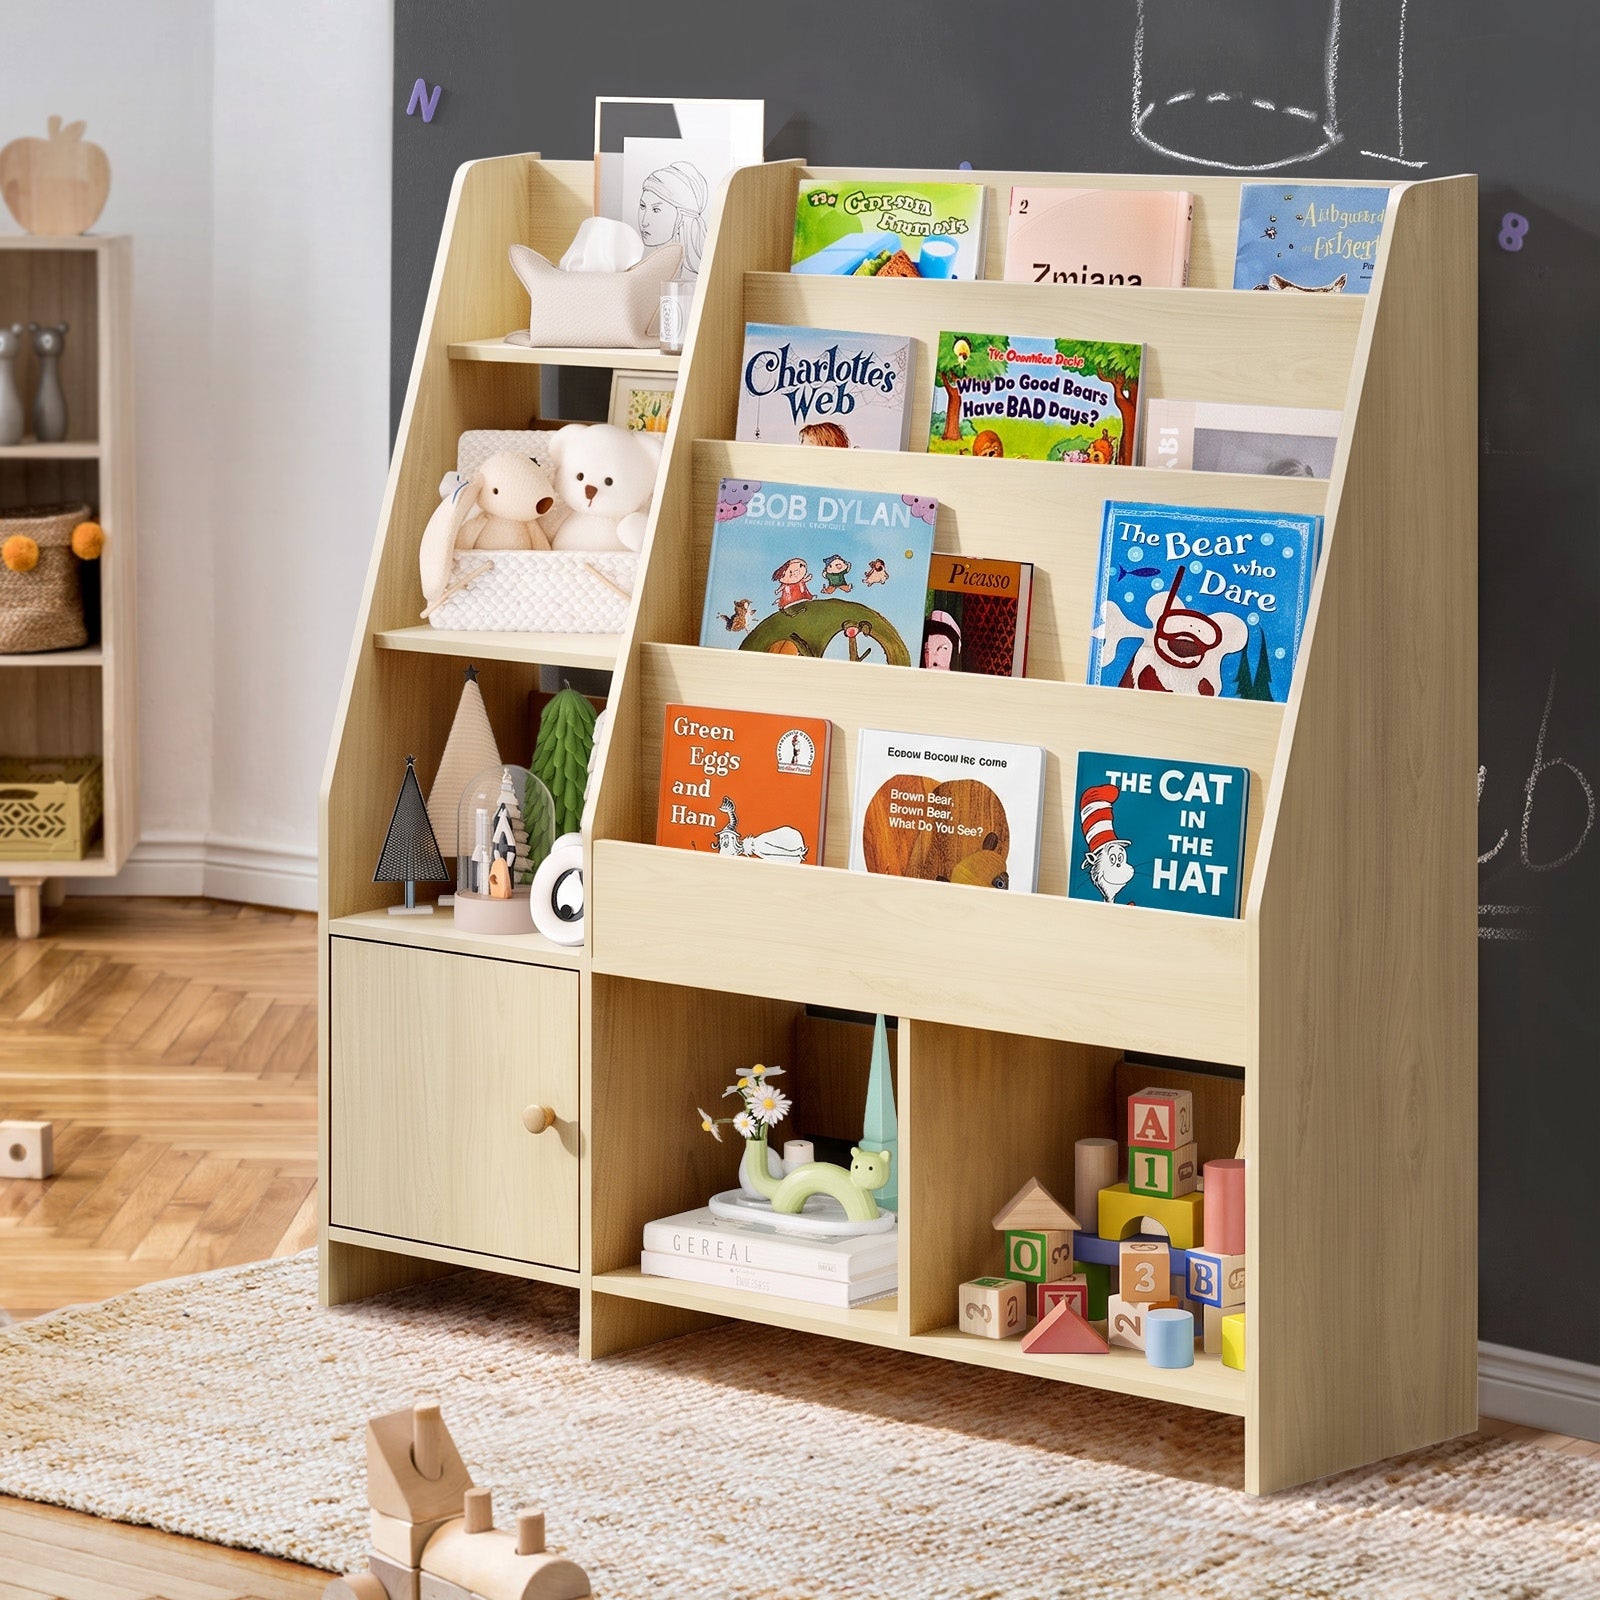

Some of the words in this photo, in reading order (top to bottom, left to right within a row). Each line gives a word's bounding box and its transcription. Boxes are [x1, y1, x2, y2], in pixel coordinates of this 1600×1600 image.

[407, 78, 441, 123] N
[1019, 199, 1029, 214] 2
[1499, 212, 1529, 251] 8
[781, 382, 854, 425] Web
[957, 377, 991, 395] Why
[995, 376, 1015, 392] Do
[1019, 374, 1059, 393] Good
[1063, 379, 1108, 406] Bears
[963, 401, 1004, 418] Have
[1006, 396, 1046, 419] BAD
[1049, 402, 1099, 427] Days?
[746, 492, 807, 520] BOB
[818, 497, 910, 528] DYLAN
[1119, 522, 1160, 546] The
[1165, 532, 1252, 561] Bear
[948, 563, 1010, 589] Picasso
[1233, 560, 1276, 578] who
[1200, 569, 1277, 612] Dare
[673, 716, 735, 741] Green
[690, 746, 741, 776] Eggs
[672, 779, 711, 798] and
[890, 789, 924, 802] Brown
[927, 792, 955, 807] Bear,
[1105, 770, 1152, 794] THE
[1159, 769, 1232, 805] CAT
[671, 804, 716, 827] Ham
[889, 817, 915, 830] What
[918, 820, 932, 831] Do
[935, 821, 955, 834] You
[957, 824, 983, 837] See?
[890, 803, 923, 816] Brown
[927, 806, 954, 821] Bear,
[1180, 810, 1206, 829] IN
[1168, 834, 1213, 857] THE
[1152, 858, 1229, 896] HAT
[1136, 1107, 1168, 1141] A
[1145, 1157, 1158, 1188] 1
[1134, 1262, 1156, 1293] 3
[1194, 1262, 1214, 1295] B
